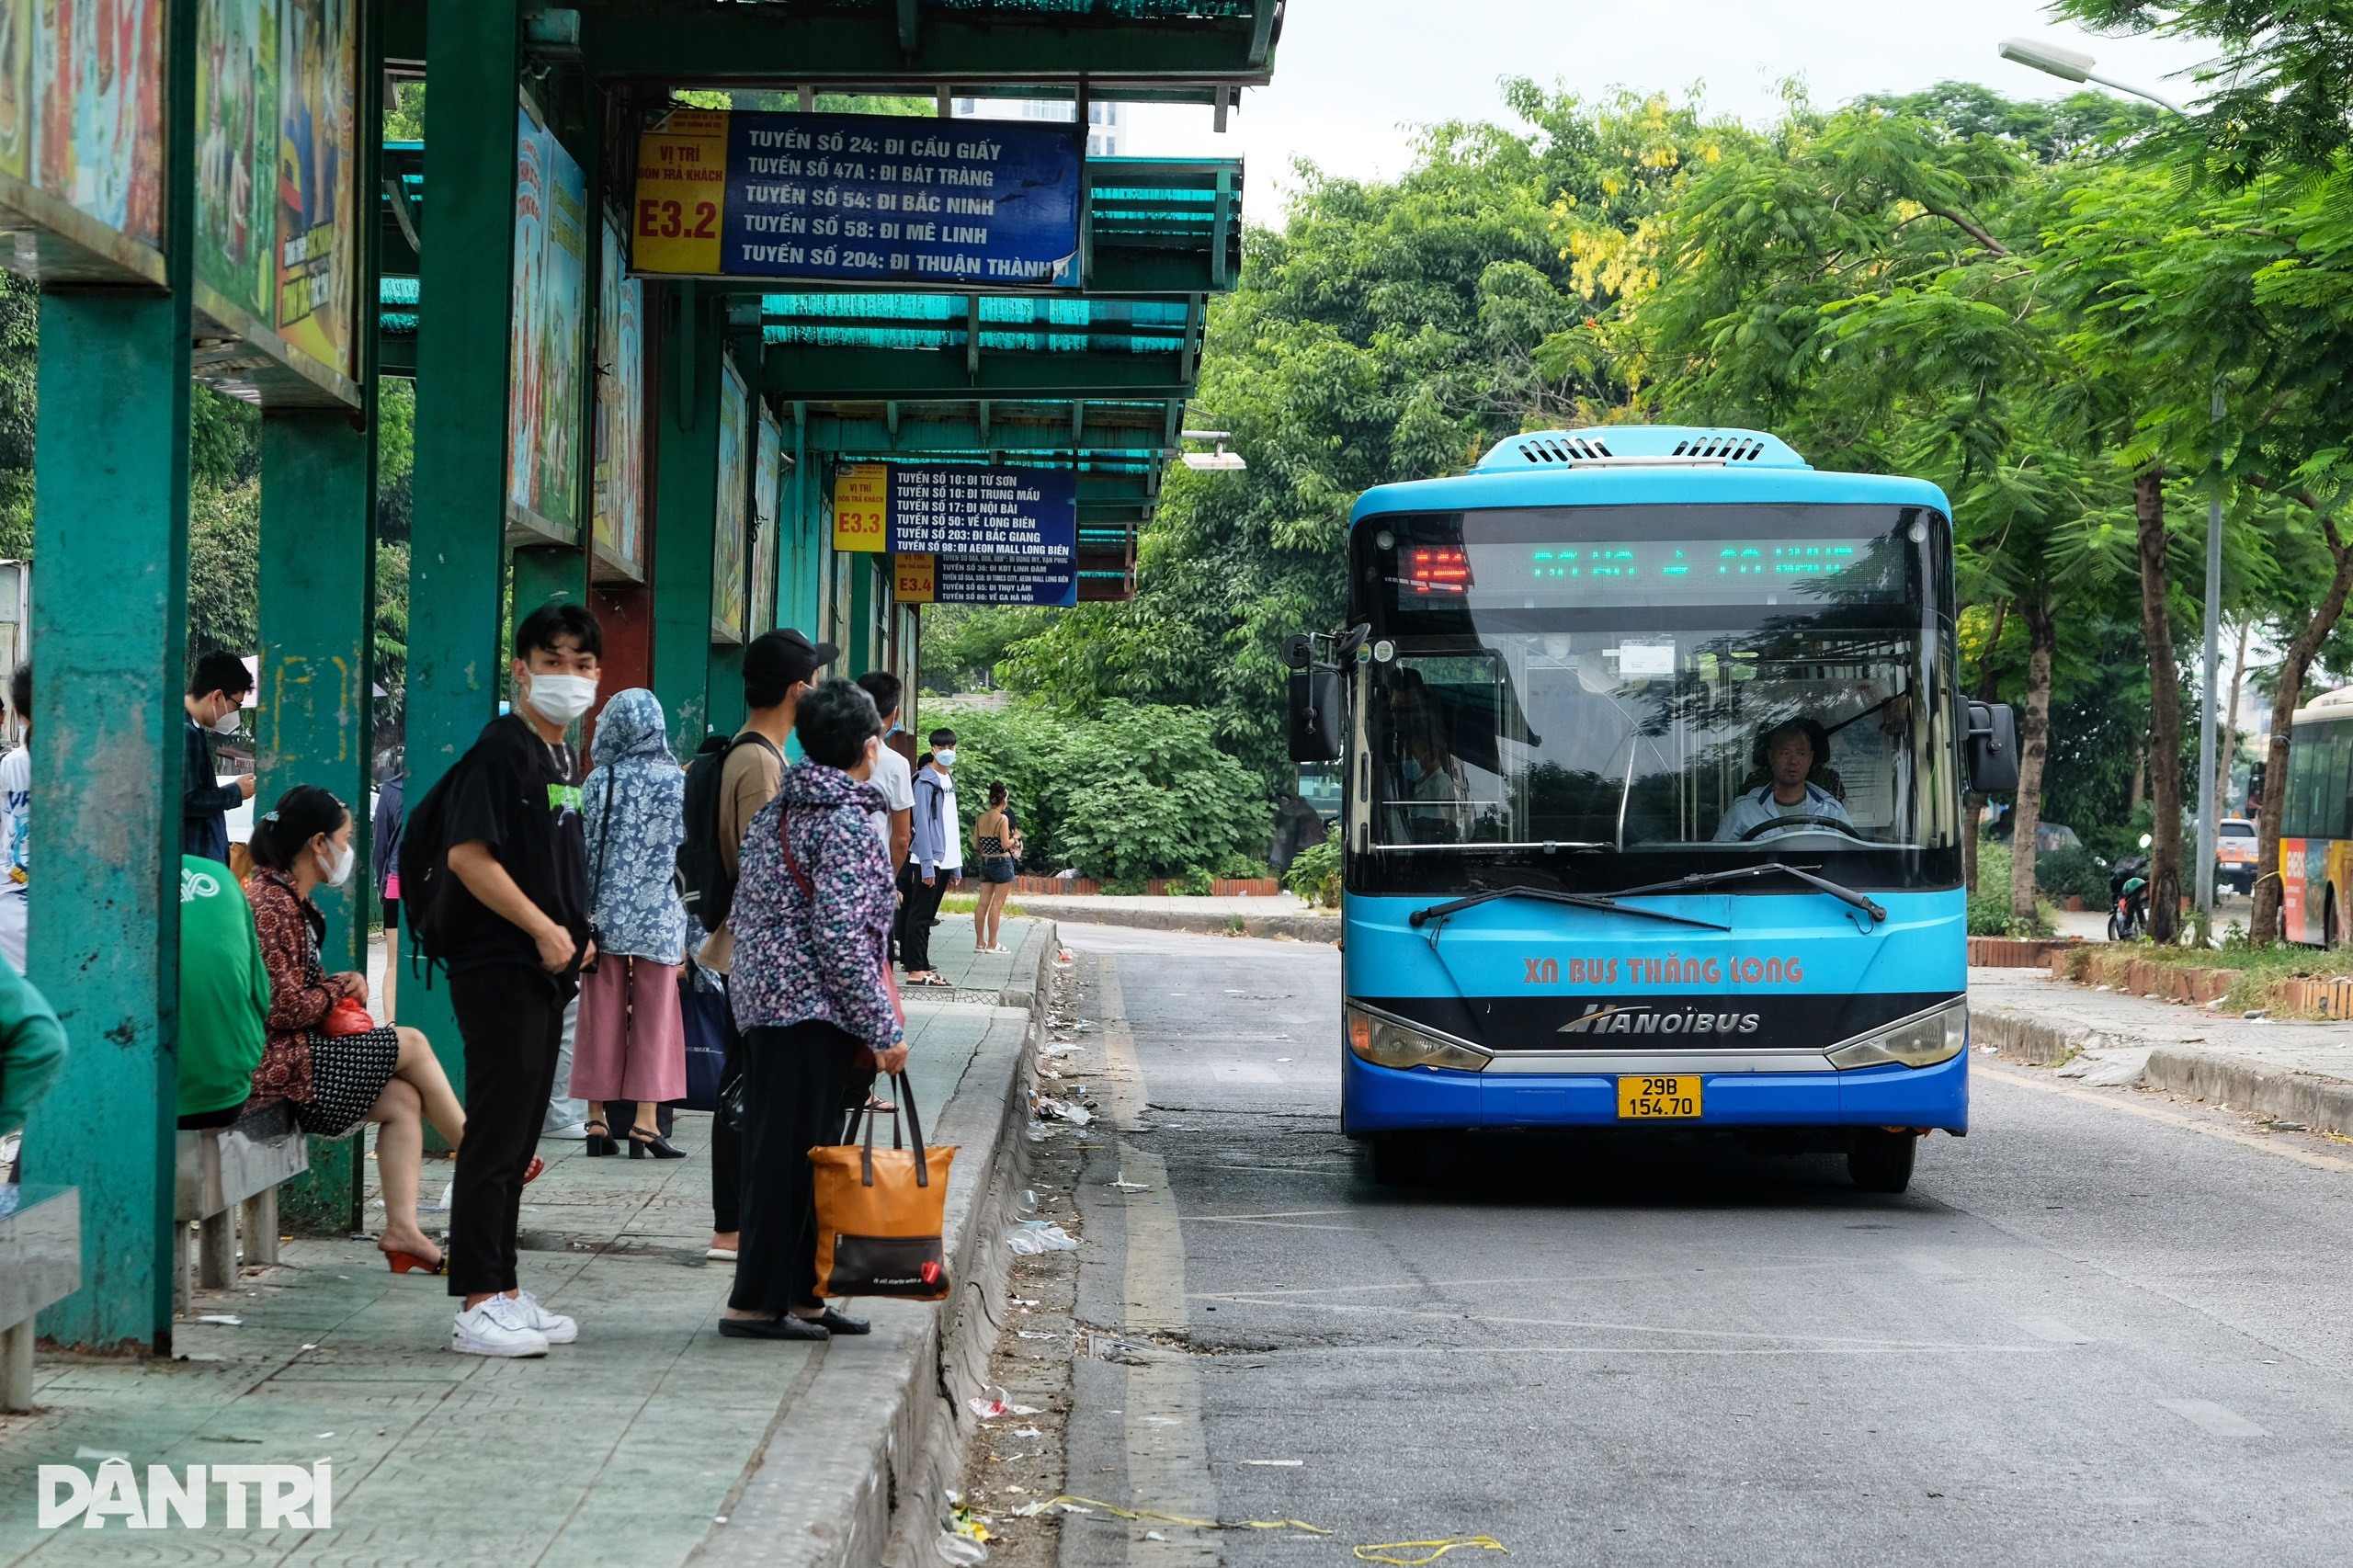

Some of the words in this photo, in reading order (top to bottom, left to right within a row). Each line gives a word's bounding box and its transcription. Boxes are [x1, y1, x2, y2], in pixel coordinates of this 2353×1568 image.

[749, 127, 811, 150] TUYẾN
[816, 130, 845, 152] SỐ
[848, 137, 879, 153] 24:
[885, 139, 904, 155] ĐI
[911, 135, 950, 158] CẦU
[957, 139, 1002, 161] GIẤY
[660, 145, 673, 165] VỊ
[677, 143, 700, 162] TRÍ
[663, 164, 683, 181] TRẢ
[686, 167, 722, 182] KHÁCH
[748, 153, 801, 176] TUYẾN
[806, 155, 830, 177] SỐ
[880, 165, 896, 181] ĐI
[902, 164, 934, 184] BÁT
[938, 165, 994, 187] TRÀNG
[745, 182, 806, 205] TUYẾN
[812, 185, 838, 207] SỐ
[843, 191, 871, 209] 54:
[877, 193, 896, 210] ĐI
[902, 190, 941, 212] BẮC
[947, 197, 994, 216] NINH
[639, 199, 717, 239] E3.2
[744, 211, 806, 233] TUYẾN
[812, 214, 840, 235] SỐ
[844, 221, 873, 238] 58:
[880, 222, 900, 240] ĐI
[905, 222, 936, 242] MÊ
[942, 226, 987, 244] LINH
[742, 241, 804, 264] TUYẾN
[810, 244, 838, 266] SỐ
[842, 251, 883, 268] 204:
[890, 253, 910, 271] ĐI
[915, 253, 981, 281] THUẬN
[849, 483, 858, 494] VỊ
[859, 482, 871, 493] TRÍ
[897, 471, 929, 483] TUYẾN
[932, 471, 947, 484] SỐ
[949, 474, 965, 485] 10:
[967, 474, 978, 485] ĐI
[981, 473, 995, 486] TỪ
[995, 475, 1017, 487] SƠN
[896, 484, 929, 497] TUYẾN
[932, 484, 947, 498] SỐ
[949, 488, 965, 499] 10:
[967, 488, 978, 499] ĐI
[981, 489, 1014, 500] TRUNG
[896, 498, 929, 511] TUYẾN
[931, 499, 946, 512] SỐ
[949, 502, 964, 513] 17:
[966, 503, 977, 513] ĐI
[979, 501, 997, 516] NỘI
[1000, 502, 1017, 515] BÀI
[839, 512, 881, 533] E3.3
[896, 512, 929, 525] TUYẾN
[931, 513, 947, 526] SỐ
[948, 517, 964, 527] 50:
[967, 513, 980, 527] VỀ
[983, 517, 1010, 528] LONG
[1012, 516, 1036, 528] BIÊN
[896, 525, 928, 539] TUYẾN
[931, 526, 947, 540] SỐ
[948, 529, 971, 540] 203:
[972, 530, 983, 541] ĐI
[985, 528, 1006, 541] BẮC
[1009, 531, 1040, 543] GIANG
[897, 539, 926, 551] TUYẾN
[927, 540, 940, 551] SỐ
[958, 543, 967, 552] ĐI
[969, 543, 994, 553] AEON
[996, 544, 1020, 554] MALL
[1022, 544, 1045, 554] LONG
[1048, 543, 1070, 555] BIÊN
[900, 577, 932, 592] E3.4
[1568, 958, 1619, 984] BUS
[1626, 951, 1722, 984] THĂNG
[1730, 956, 1803, 984] LONG
[1642, 1078, 1677, 1096] 29B
[1630, 1097, 1693, 1116] 154.70
